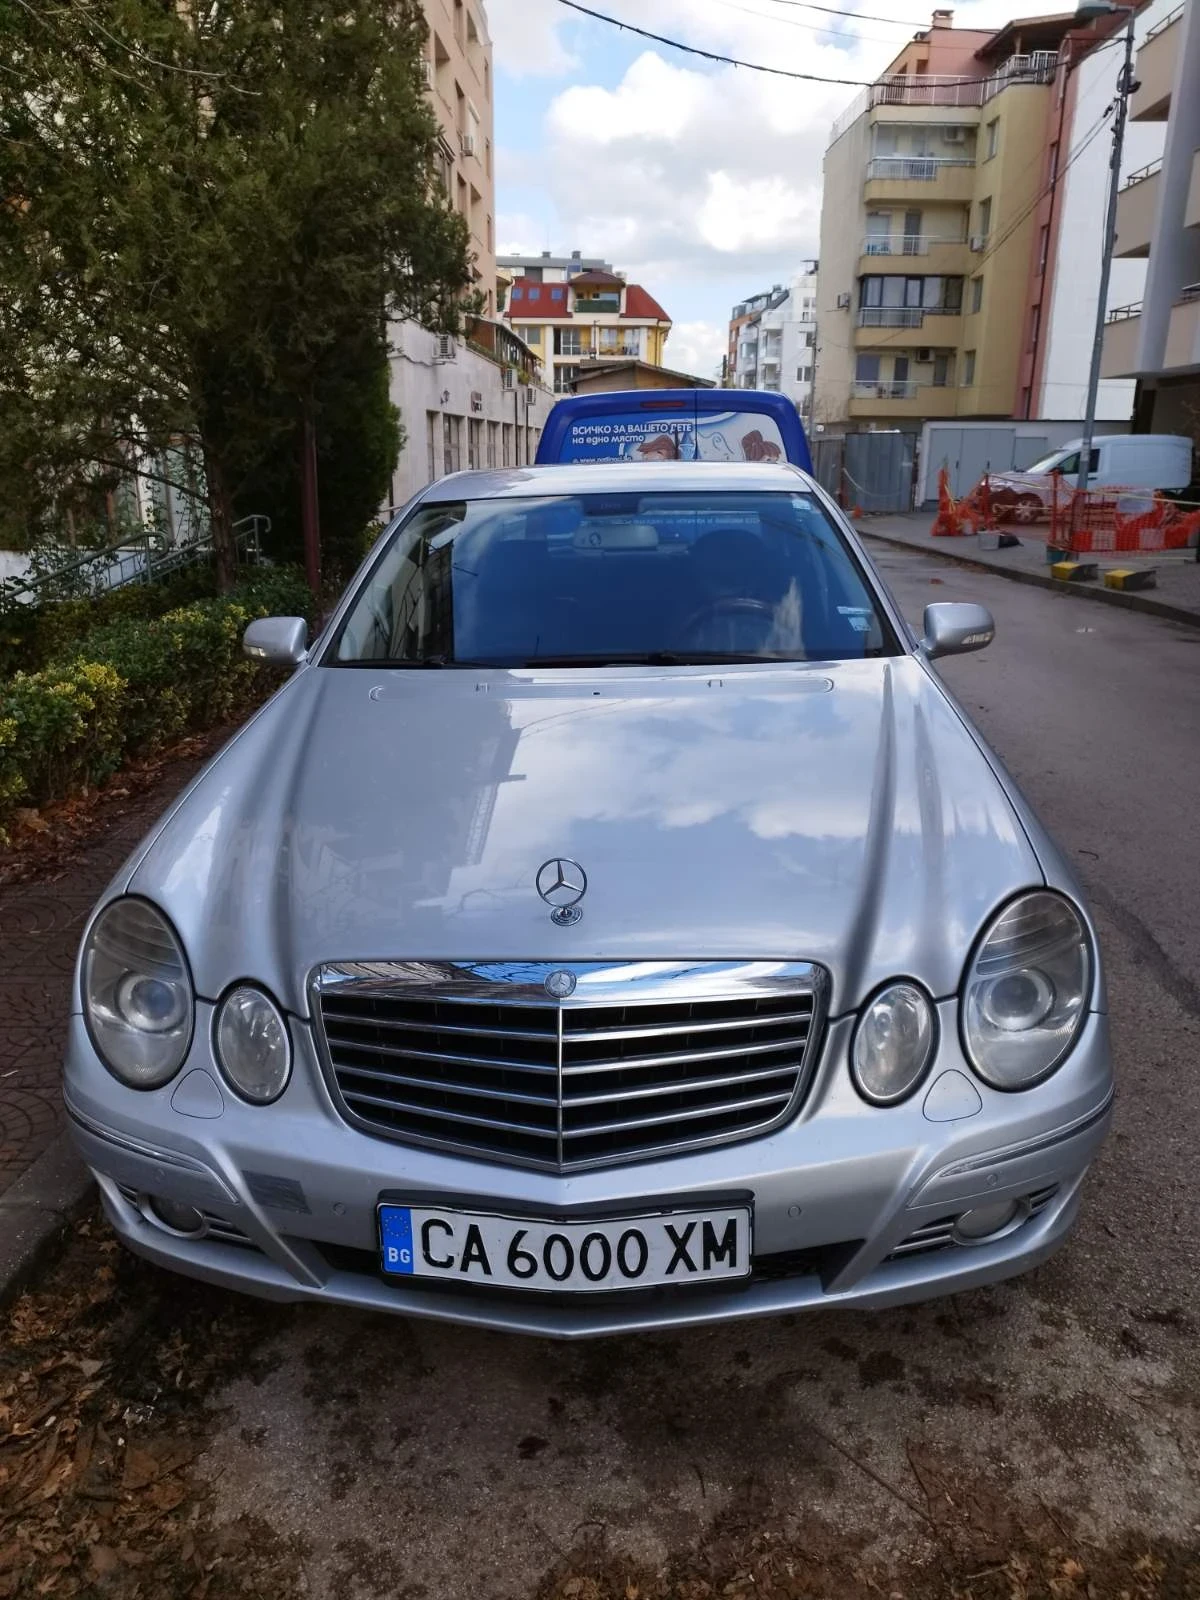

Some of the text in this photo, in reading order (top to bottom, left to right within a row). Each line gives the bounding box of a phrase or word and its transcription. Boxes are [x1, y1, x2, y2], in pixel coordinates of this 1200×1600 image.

[572, 425, 612, 436] ВСИЧКО
[613, 424, 626, 434] ЗА
[627, 423, 669, 433] ВАШЕТО
[388, 1247, 411, 1264] BG
[420, 1218, 738, 1282] CA 6000 XM
